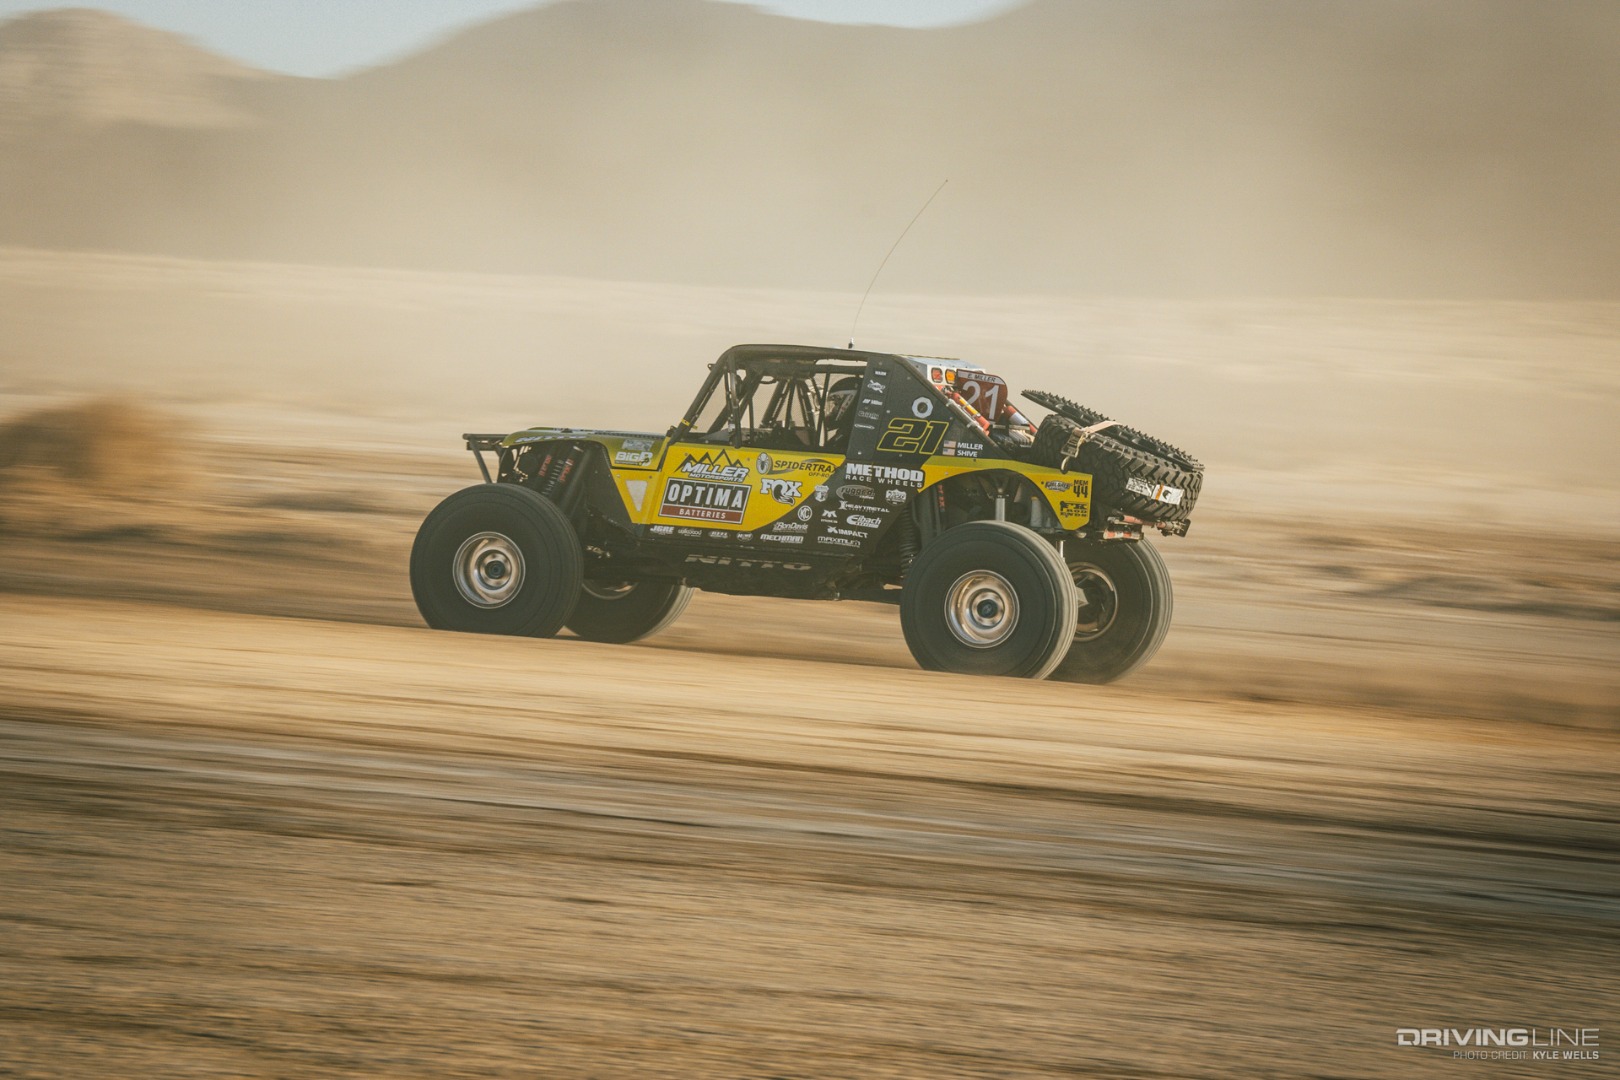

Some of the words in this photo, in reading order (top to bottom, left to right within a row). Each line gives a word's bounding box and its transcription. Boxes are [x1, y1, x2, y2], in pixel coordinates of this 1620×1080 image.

[974, 374, 996, 382] MILLER
[962, 380, 1000, 420] 21
[876, 417, 950, 454] 21
[957, 442, 984, 450] MILLER
[957, 450, 978, 458] SHIVE
[682, 462, 750, 478] MILLER
[846, 462, 924, 482] METHOD
[688, 472, 744, 483] MOTORSPORTS
[845, 474, 872, 483] RACE
[878, 478, 923, 488] WHEELS
[668, 483, 744, 508] OPTIMA
[760, 478, 802, 502] FOX
[679, 509, 726, 519] BATTERIES
[838, 529, 868, 539] IMPACT
